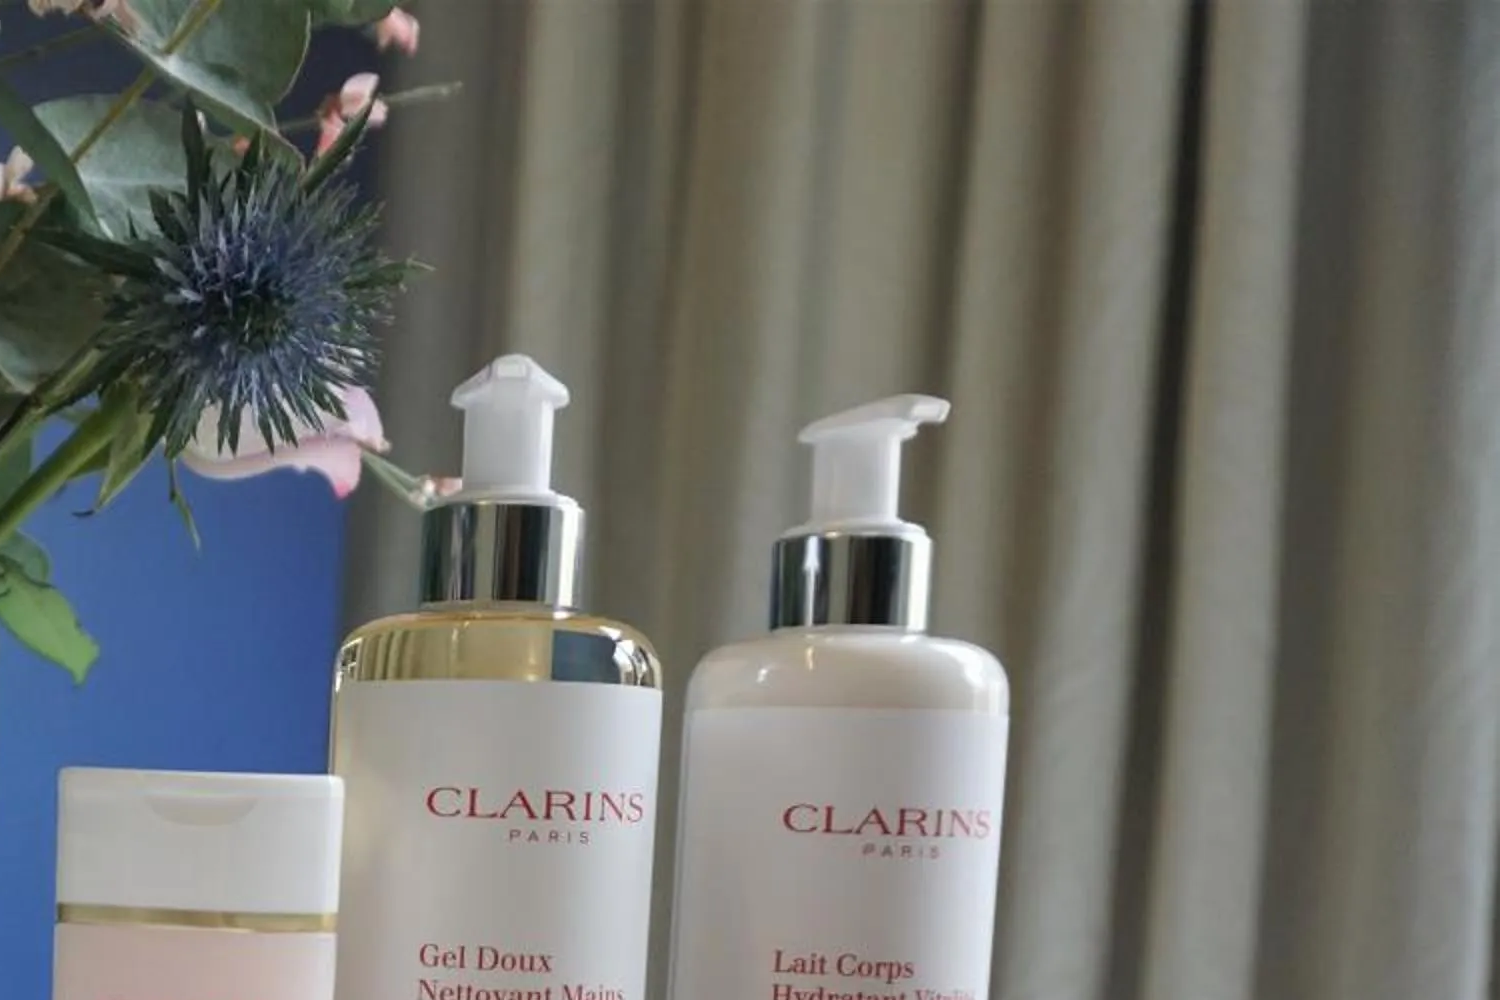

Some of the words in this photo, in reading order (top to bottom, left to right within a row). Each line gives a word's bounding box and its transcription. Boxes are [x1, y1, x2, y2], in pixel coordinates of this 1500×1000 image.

[426, 787, 644, 823] CLARINS
[782, 803, 990, 838] CLARINS
[509, 829, 590, 844] PARIS
[862, 843, 940, 859] PARIS
[419, 944, 465, 969] Gel
[476, 946, 553, 973] Doux
[773, 950, 827, 975] Lait
[836, 952, 914, 984] Corps
